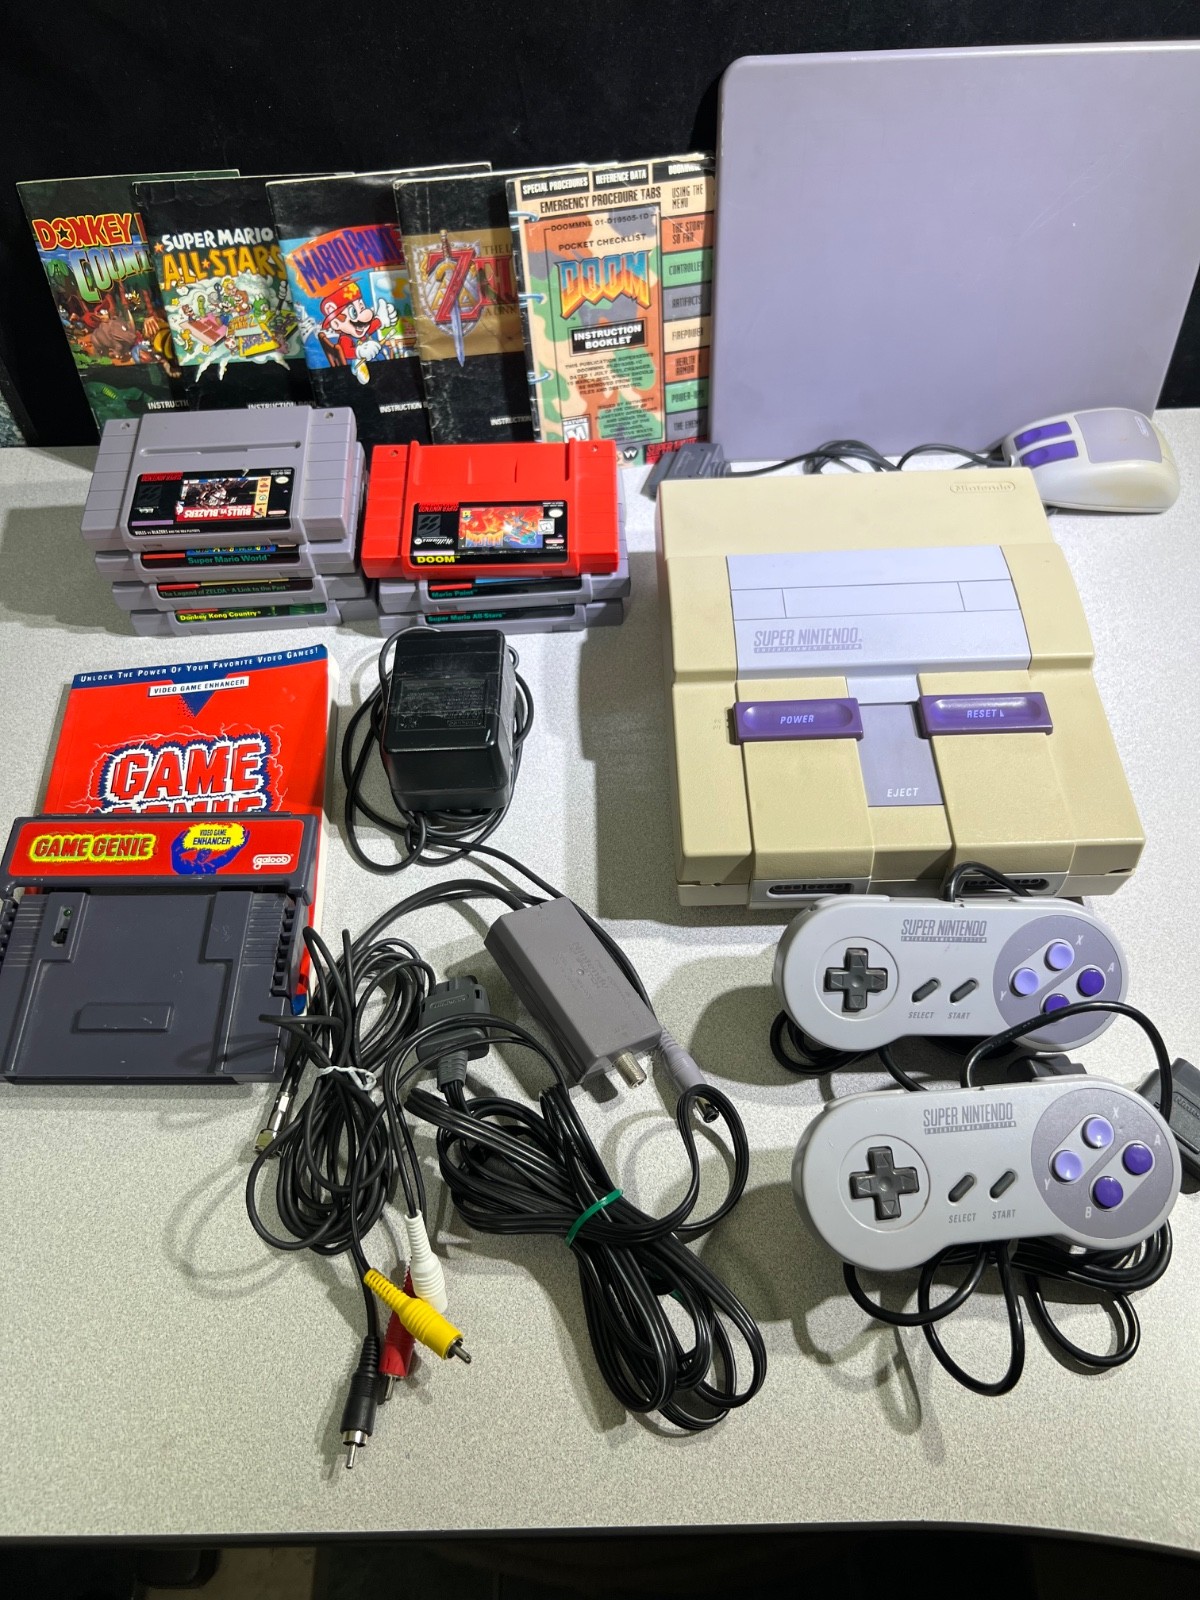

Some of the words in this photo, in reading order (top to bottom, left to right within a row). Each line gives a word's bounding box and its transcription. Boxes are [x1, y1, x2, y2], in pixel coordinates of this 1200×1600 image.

[595, 171, 629, 185] REFERENCE
[630, 169, 647, 180] DATA
[522, 182, 548, 195] SPECIAL
[549, 176, 588, 191] PROCEDURES
[672, 186, 690, 198] USING
[693, 184, 703, 196] THE
[540, 196, 590, 214] EMERGENCY
[592, 190, 638, 206] PROCEDURE
[641, 186, 662, 200] TABS
[32, 213, 133, 250] DONKEY
[550, 220, 593, 232] DOOMMNL
[161, 230, 218, 252] SUPER
[216, 226, 274, 247] MARIO
[559, 241, 594, 251] POCKET
[596, 234, 646, 246] CHECKLIST
[292, 237, 358, 294] MARIO
[555, 250, 652, 319] DOOM
[574, 324, 642, 342] INSTRUCTION
[584, 336, 632, 350] BOOKLET
[379, 401, 422, 414] INSTRUCTION
[184, 508, 219, 518] BLAZERS
[227, 508, 252, 516] BULLS
[188, 557, 213, 565] Super
[240, 554, 268, 562] World
[173, 590, 198, 598] Legend
[180, 613, 206, 621] Donkey
[208, 612, 228, 620] Kong
[228, 611, 257, 619] Country
[754, 630, 794, 647] SUPER
[798, 628, 859, 645] NINTENDO
[138, 668, 167, 676] POWER
[171, 666, 182, 674] OF
[186, 664, 208, 672] YOUR
[214, 659, 253, 668] FAVORITE
[258, 654, 282, 664] VIDEO
[154, 686, 178, 694] VIDEO
[180, 684, 202, 692] GAME
[204, 678, 246, 690] ENHANCER
[780, 714, 814, 724] POWER
[967, 709, 997, 718] RESET
[110, 743, 262, 800] GAME
[887, 788, 919, 798] EJECT
[200, 828, 214, 836] VIDEO
[214, 828, 227, 836] GAME
[35, 837, 92, 857] GAME
[92, 836, 152, 857] GENIE
[192, 836, 232, 846] ENHANCER
[254, 854, 290, 869] galoob
[901, 919, 936, 936] SUPER
[937, 920, 987, 936] NINTENDO
[1076, 935, 1084, 946] X
[1107, 962, 1116, 973] A
[1000, 990, 1007, 1000] Y
[908, 1011, 934, 1019] SELECT
[948, 1012, 971, 1020] START
[923, 1106, 958, 1127] SUPER
[962, 1102, 1013, 1124] NINTENDO
[1112, 1107, 1120, 1119] X
[1154, 1134, 1161, 1146] A
[1044, 1178, 1050, 1191] Y
[948, 1212, 976, 1224] SELECT
[992, 1208, 1016, 1220] START
[1084, 1207, 1092, 1218] B
